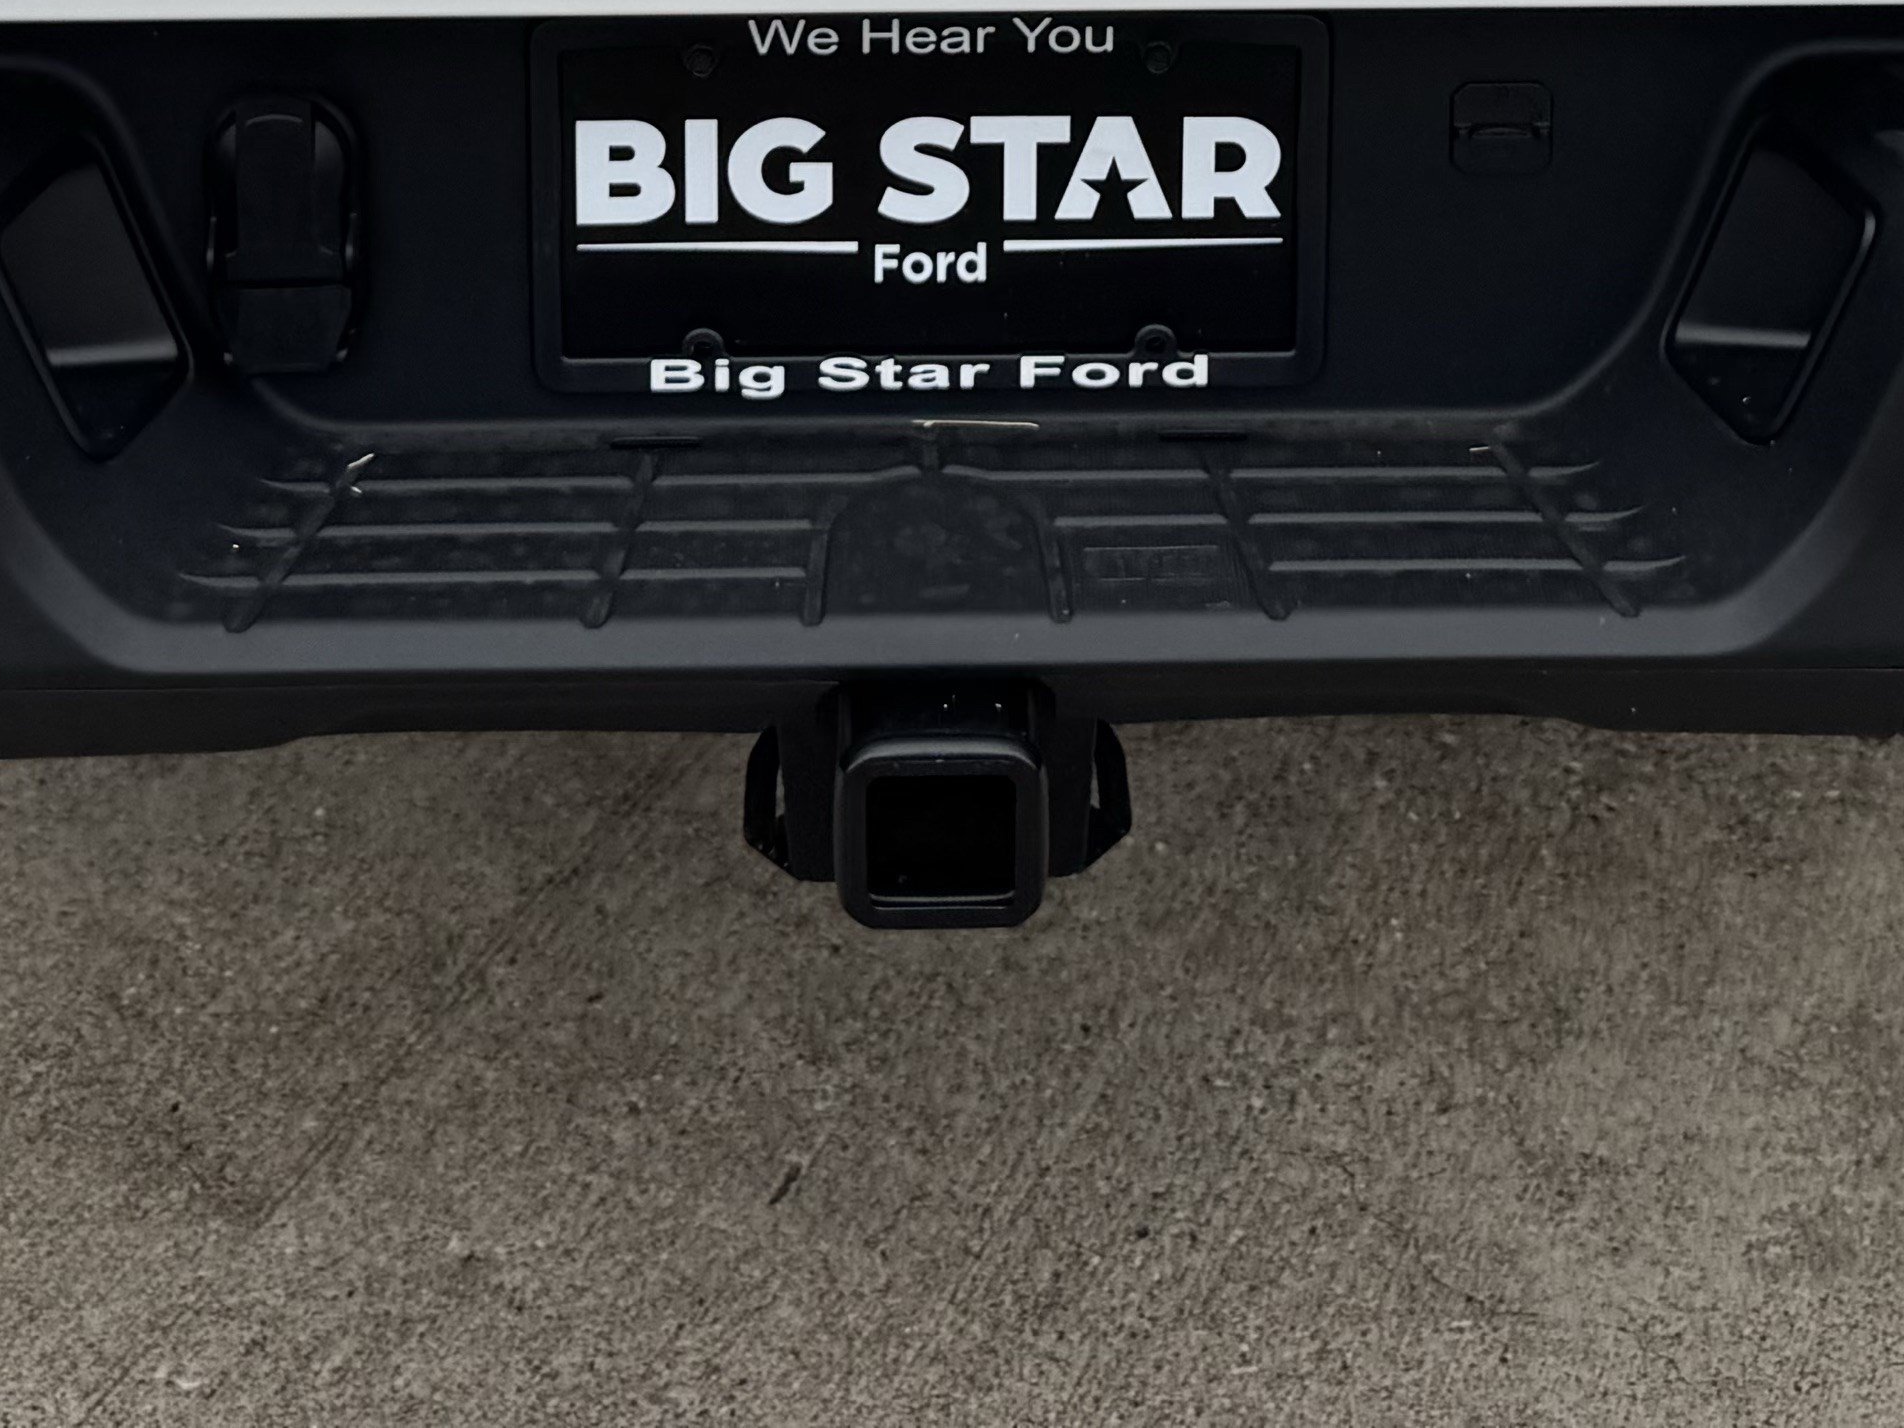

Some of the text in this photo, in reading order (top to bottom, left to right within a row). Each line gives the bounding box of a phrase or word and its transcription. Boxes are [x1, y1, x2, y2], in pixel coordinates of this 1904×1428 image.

[749, 18, 1113, 54] We Hear You
[576, 116, 1281, 225] BIG STAR
[875, 242, 986, 283] Ford
[651, 355, 1208, 398] Big Star Ford
